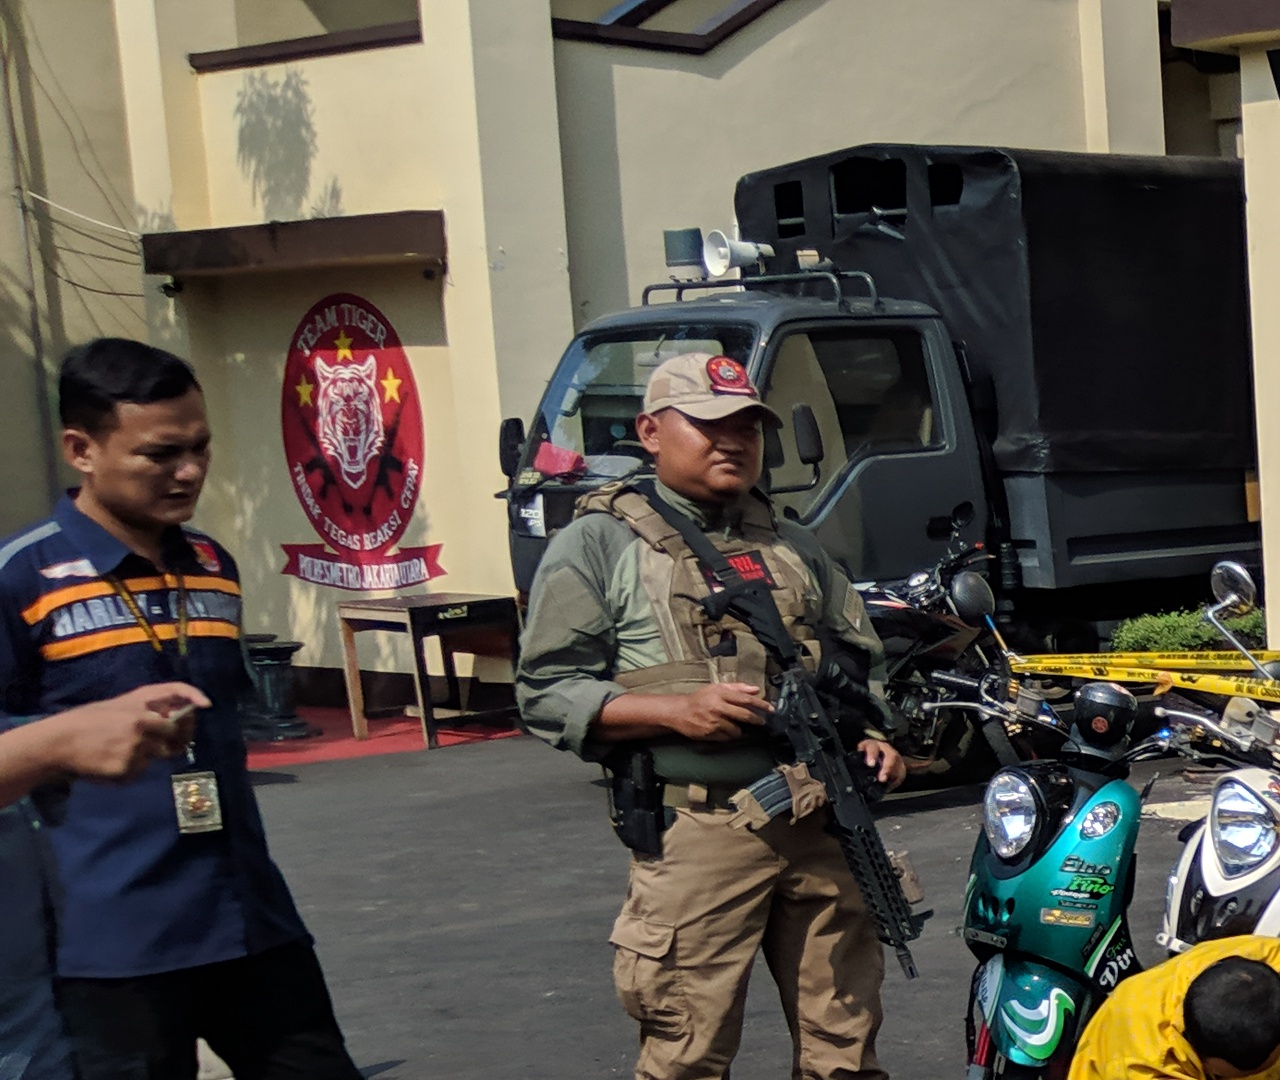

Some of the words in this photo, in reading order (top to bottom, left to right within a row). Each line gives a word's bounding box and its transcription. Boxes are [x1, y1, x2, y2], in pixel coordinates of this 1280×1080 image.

[297, 306, 338, 357] TEAM
[340, 303, 387, 350] TIGER
[322, 516, 361, 550] TEGAS
[362, 509, 403, 550] REAKSI
[361, 562, 400, 589] JAKARTA
[1069, 875, 1115, 895] Fino
